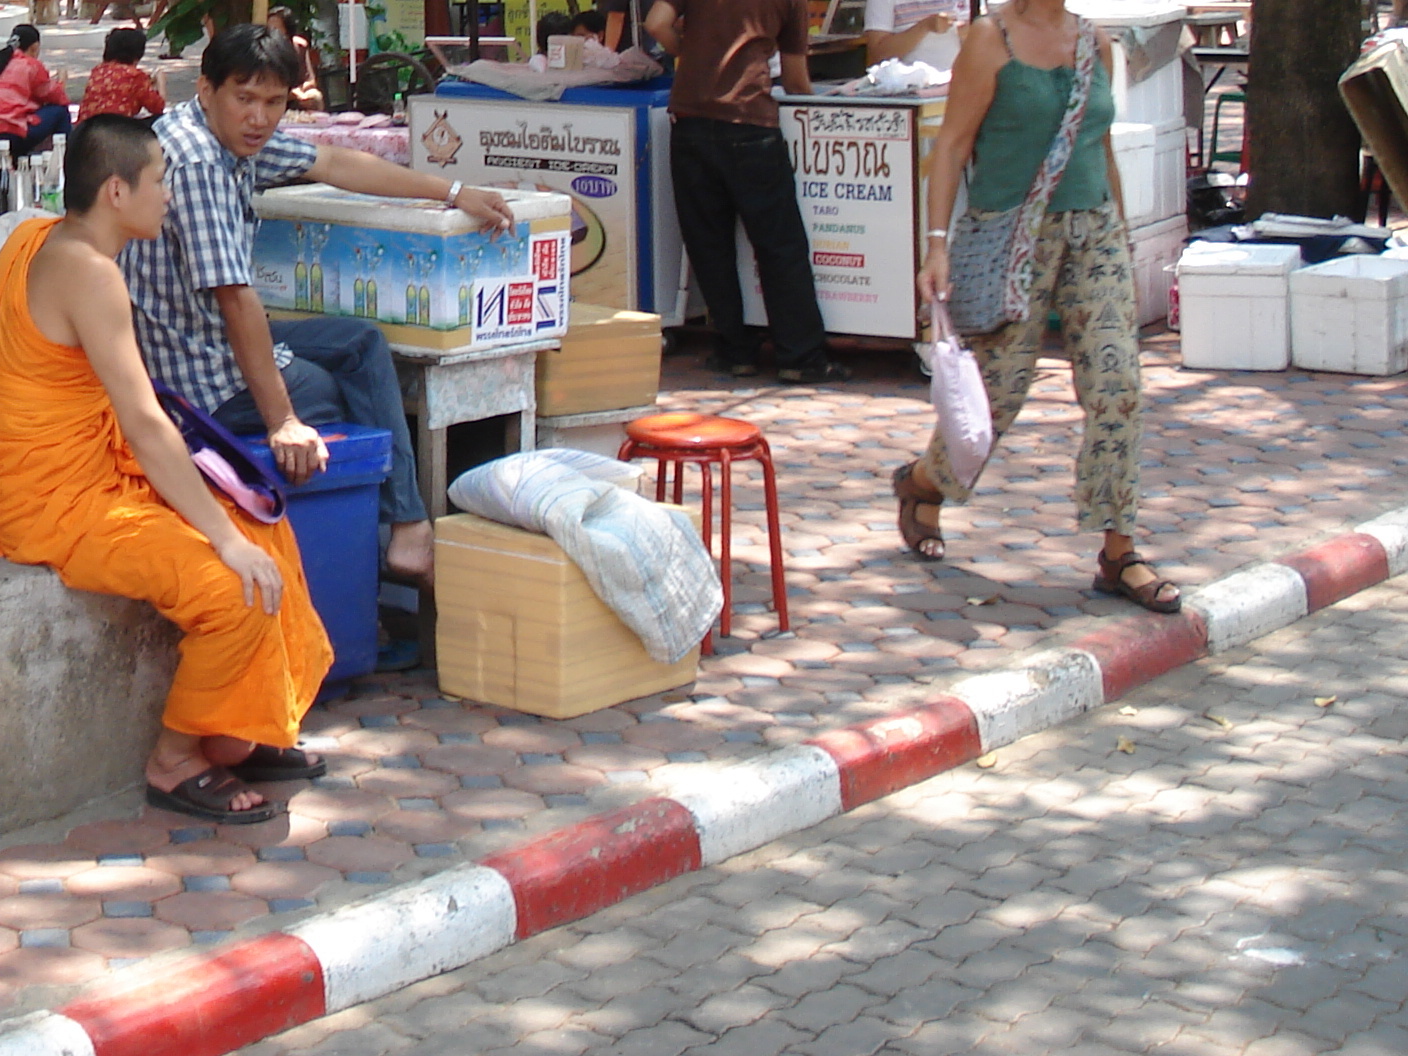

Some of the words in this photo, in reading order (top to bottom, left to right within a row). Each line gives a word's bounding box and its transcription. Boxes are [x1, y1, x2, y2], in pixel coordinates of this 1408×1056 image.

[487, 155, 542, 170] ANCIENT
[802, 181, 829, 198] ICE
[834, 183, 893, 202] CREAM
[813, 205, 839, 216] TARO
[812, 223, 866, 235] PANDANUS
[815, 254, 863, 266] COCONUT
[814, 273, 871, 286] CHOCOLATE
